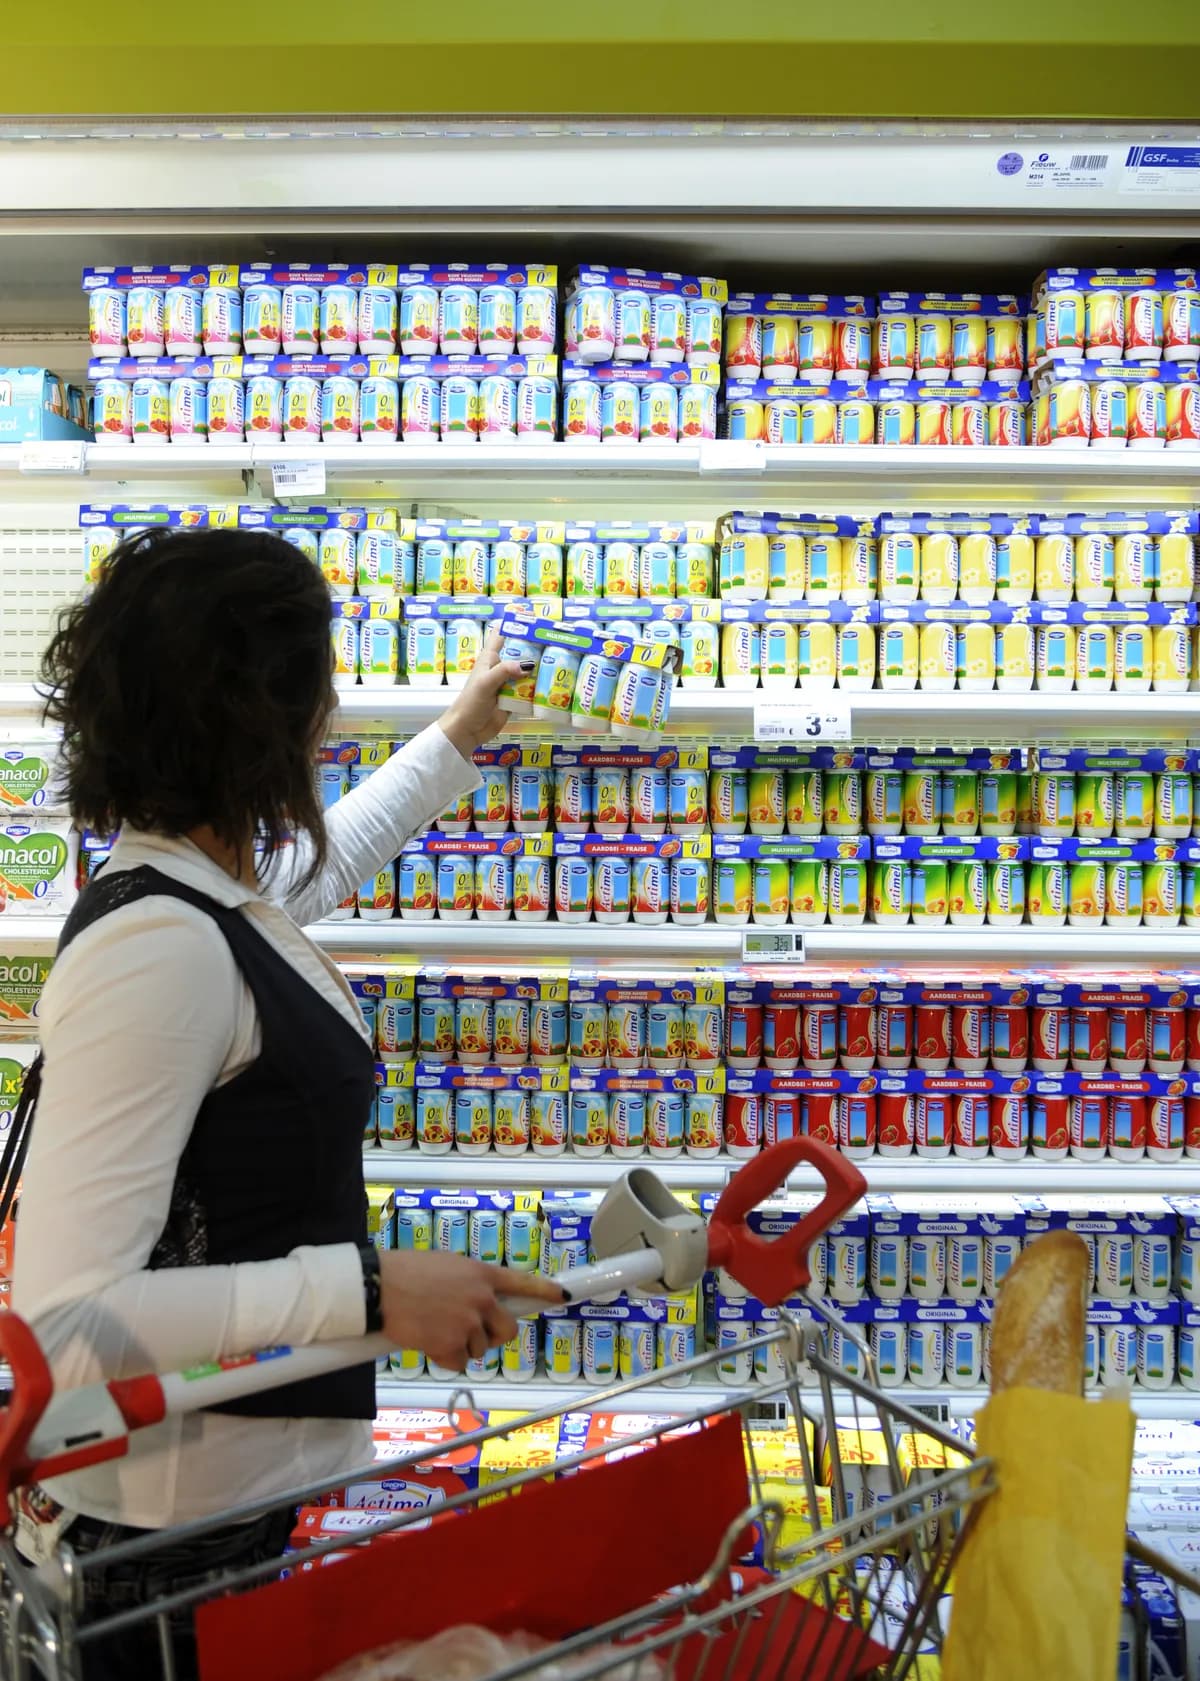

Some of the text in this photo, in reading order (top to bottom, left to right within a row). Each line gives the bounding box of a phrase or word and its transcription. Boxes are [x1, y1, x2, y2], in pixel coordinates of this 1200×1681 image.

[1143, 153, 1167, 162] GSF
[579, 662, 599, 712] Actimel
[616, 671, 638, 722] Actimel
[806, 717, 821, 735] 3
